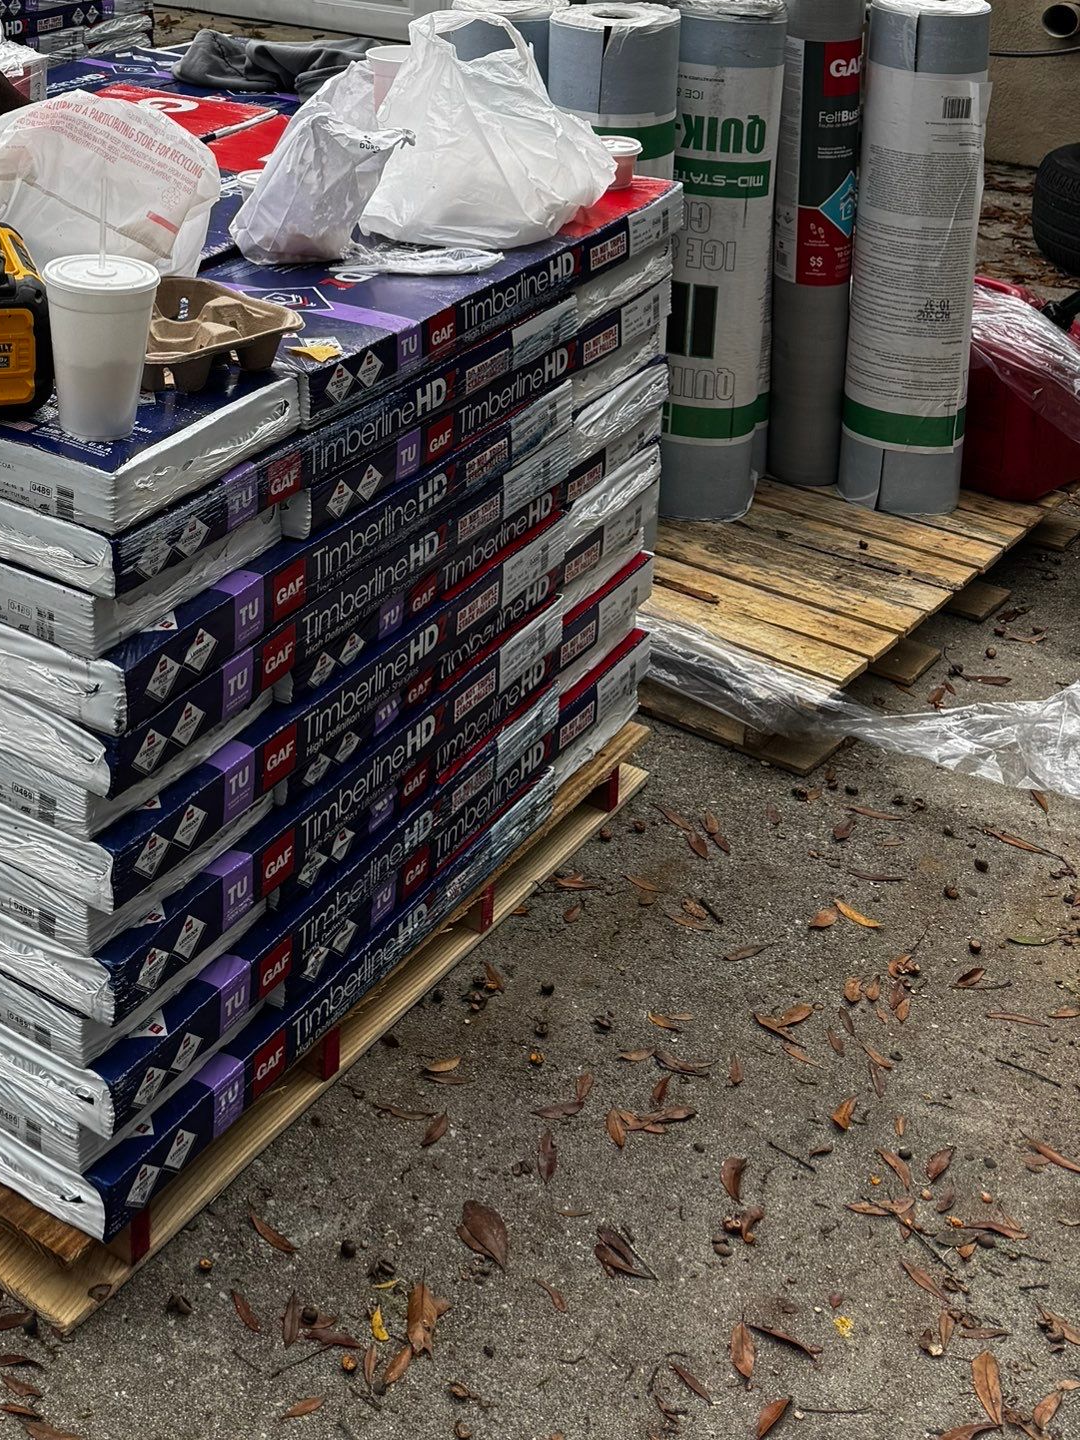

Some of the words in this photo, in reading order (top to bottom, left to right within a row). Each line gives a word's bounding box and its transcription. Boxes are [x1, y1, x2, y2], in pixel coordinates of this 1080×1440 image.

[685, 88, 704, 100] ICE
[819, 109, 861, 123] FeltBus
[81, 106, 88, 116] A
[89, 108, 135, 140] PARTICIPATING
[134, 130, 155, 151] STORE
[156, 142, 170, 157] FOR
[169, 148, 205, 179] RECYCLING
[591, 250, 597, 259] DO
[610, 236, 626, 251] TRIPLE
[591, 256, 605, 269] STACK
[606, 244, 626, 262] PALLETS
[686, 237, 737, 272] ICE
[400, 335, 418, 356] TU
[431, 322, 454, 346] GAF
[585, 343, 592, 352] DO
[603, 326, 618, 342] TRIPLE
[400, 444, 417, 466] TU
[429, 428, 452, 453] GAF
[31, 483, 51, 497] 0489
[270, 469, 299, 495] GAF
[239, 597, 259, 626] TU
[276, 574, 304, 606] GAF
[382, 604, 400, 631] TU
[412, 586, 436, 613] GAF
[228, 667, 248, 696] TU
[264, 641, 294, 674] GAF
[408, 676, 432, 704] GAF
[305, 737, 324, 757] High
[229, 765, 250, 796] TU
[265, 739, 295, 773] GAF
[403, 769, 427, 797] GAF
[227, 876, 248, 905] TU
[264, 846, 294, 879] GAF
[376, 885, 393, 910] TU
[404, 859, 428, 885] GAF
[225, 989, 245, 1017] TU
[262, 951, 290, 987] GAF
[218, 1078, 240, 1116] TU
[256, 1045, 284, 1082] GAF
